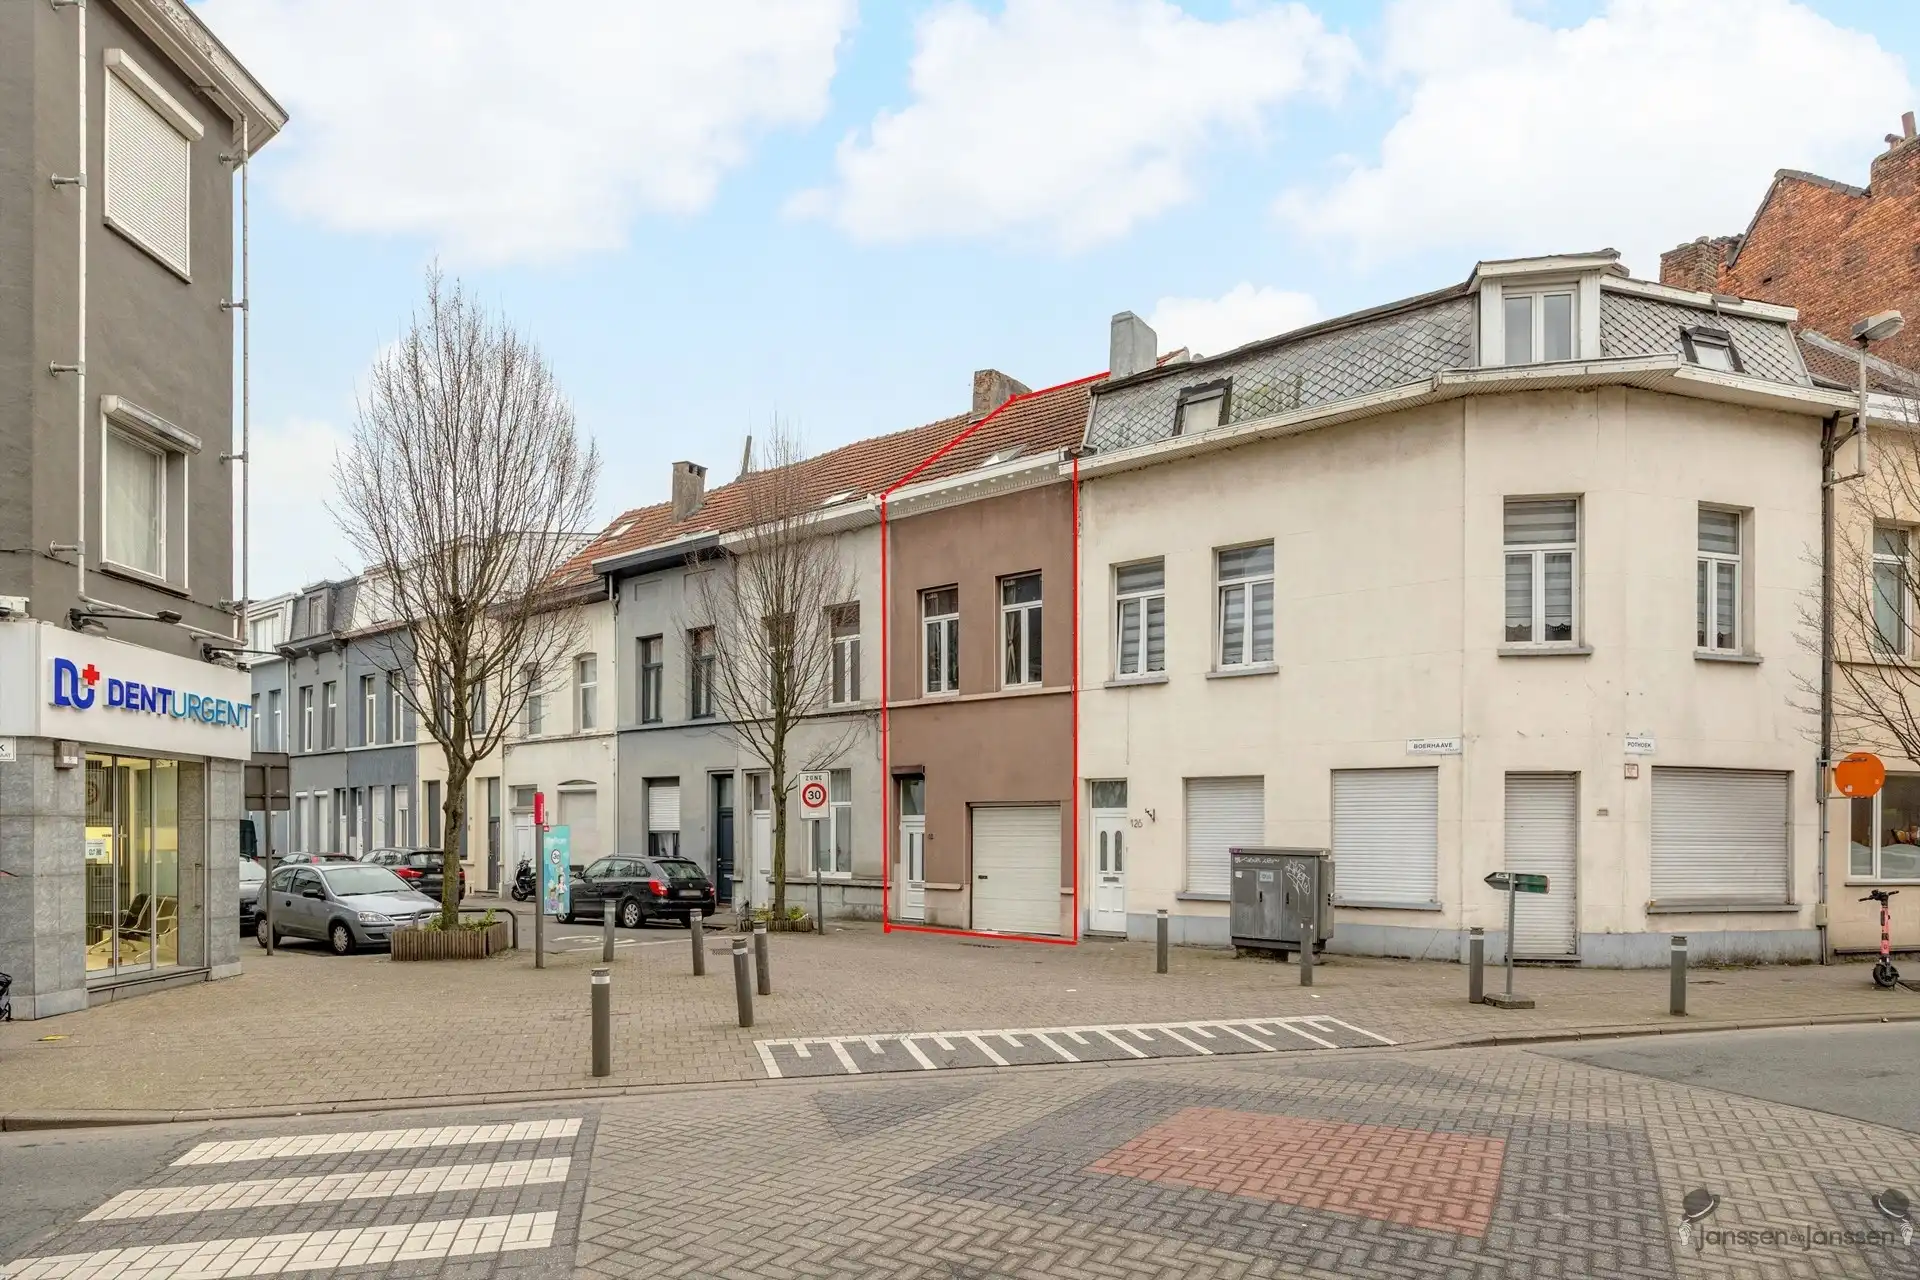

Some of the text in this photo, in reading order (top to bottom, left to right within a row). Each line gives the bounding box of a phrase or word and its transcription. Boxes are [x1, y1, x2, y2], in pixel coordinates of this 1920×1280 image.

[107, 676, 252, 729] DENTURGENT
[1413, 742, 1453, 750] BOERHAAVE
[808, 790, 821, 800] 30
